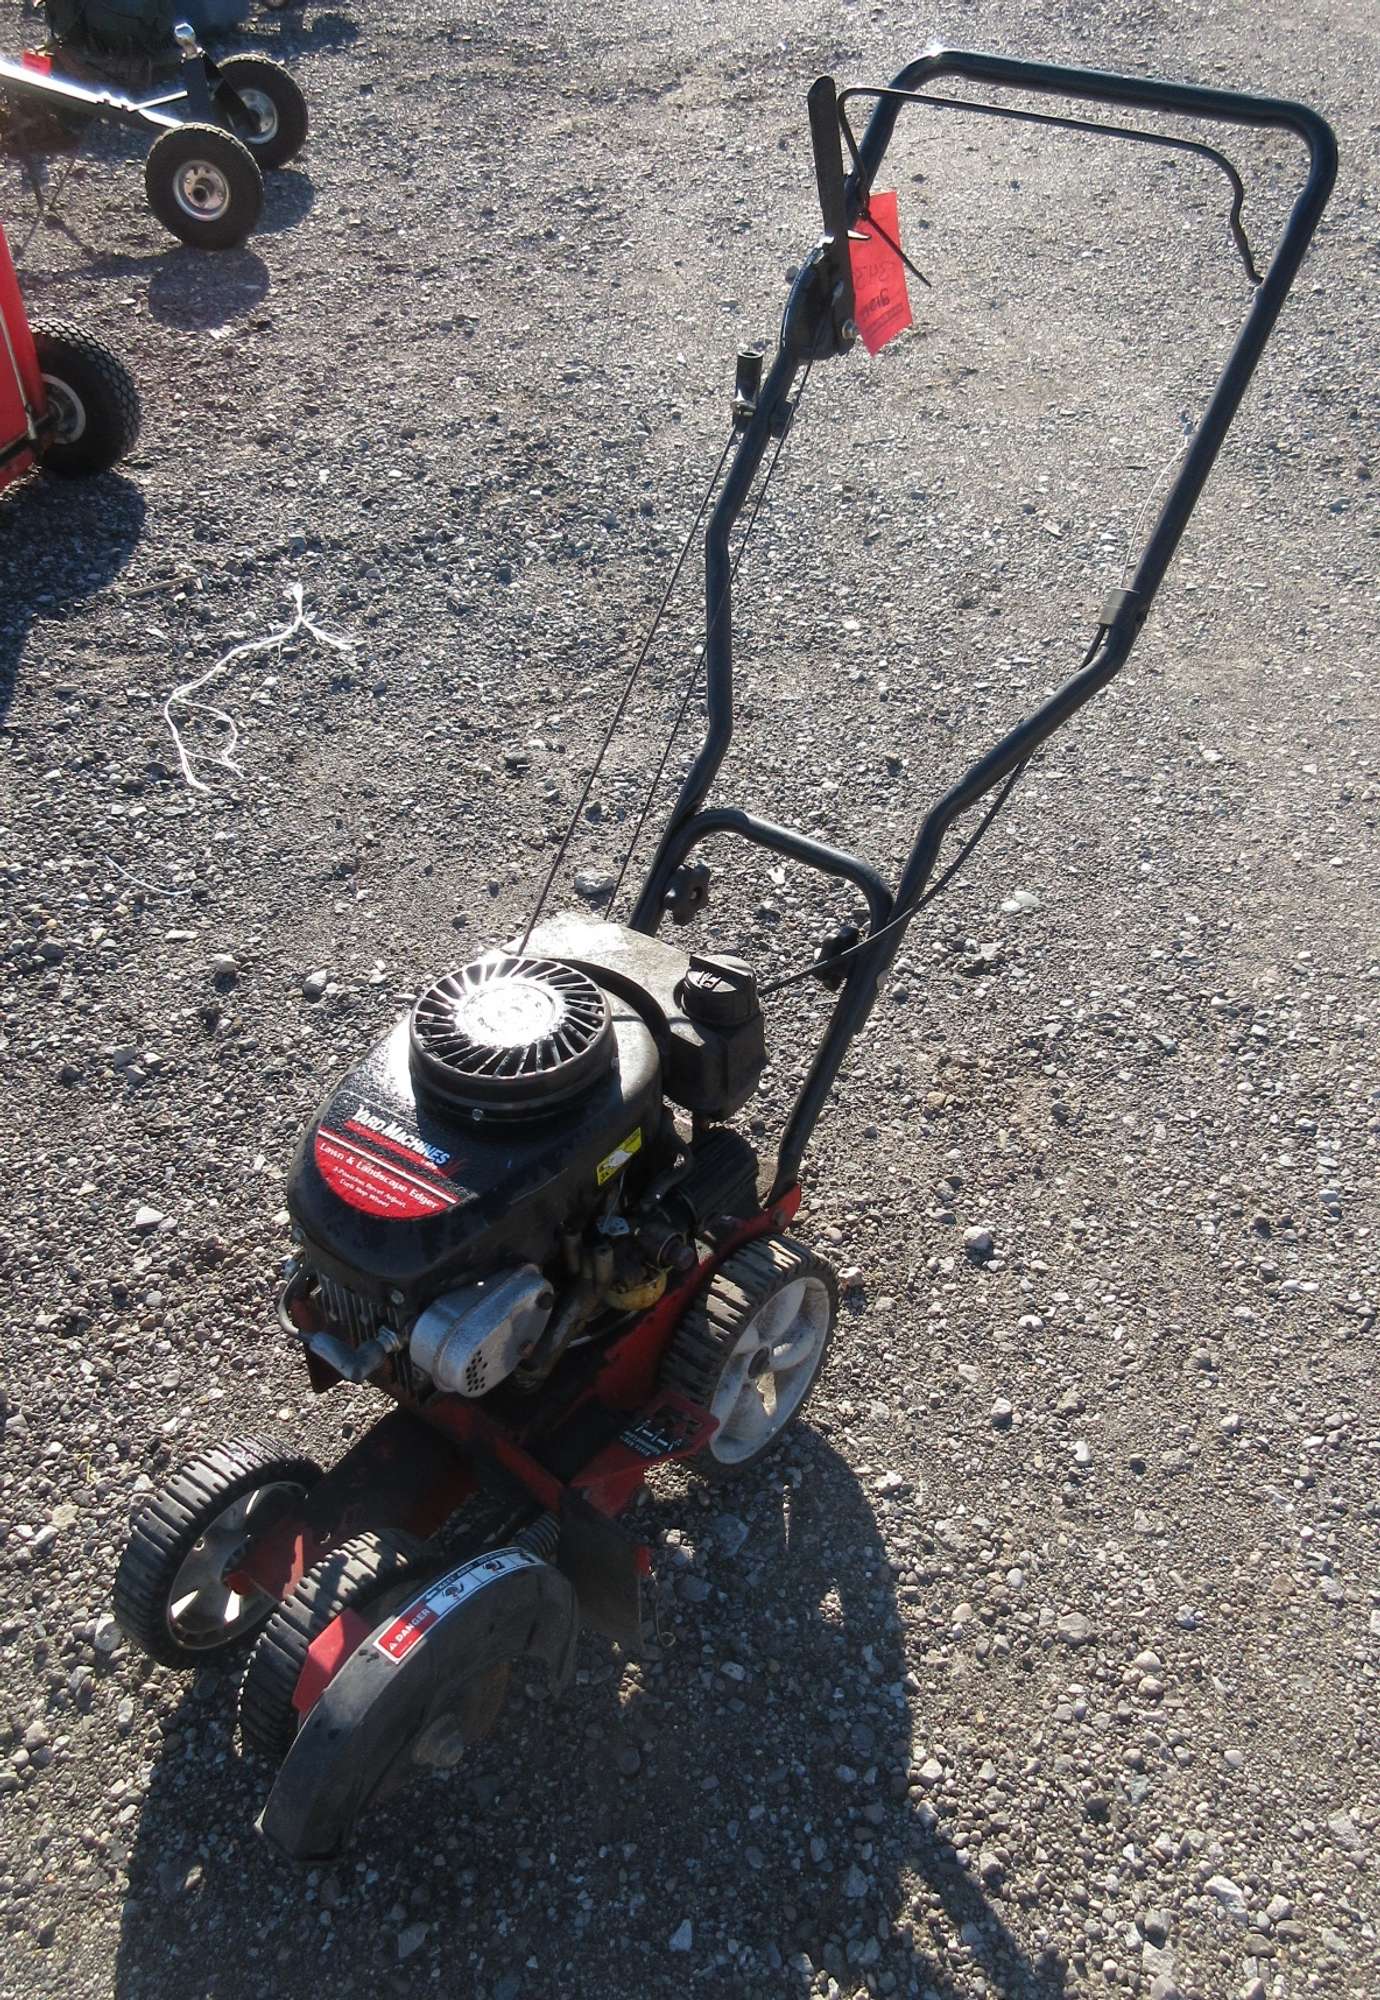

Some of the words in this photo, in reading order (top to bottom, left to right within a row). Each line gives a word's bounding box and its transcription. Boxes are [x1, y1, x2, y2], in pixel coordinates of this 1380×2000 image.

[351, 1103, 383, 1131] YARD
[381, 1121, 450, 1164] MACHINES
[320, 1142, 343, 1160] Lawn
[345, 1156, 355, 1165] &
[356, 1160, 408, 1192] Landscape
[409, 1188, 440, 1209] Edger
[395, 1608, 431, 1643] DANGER
